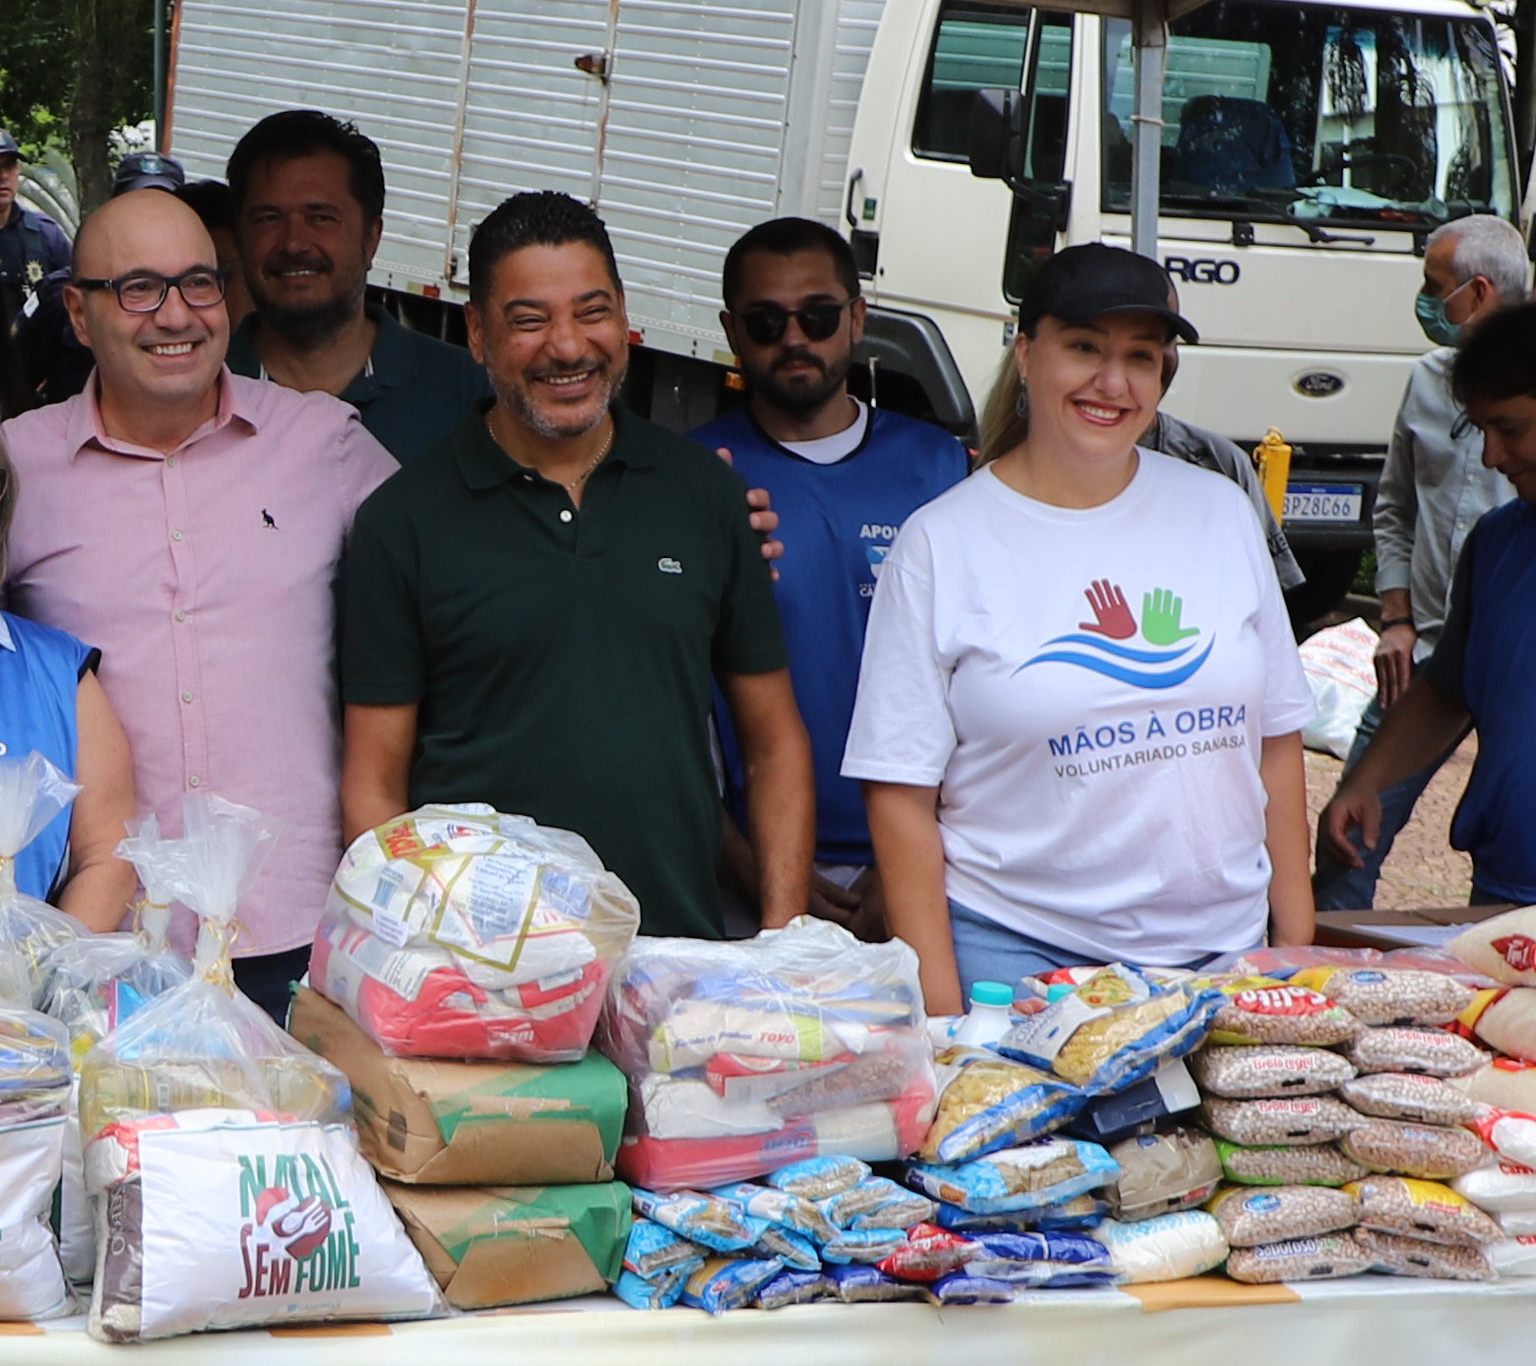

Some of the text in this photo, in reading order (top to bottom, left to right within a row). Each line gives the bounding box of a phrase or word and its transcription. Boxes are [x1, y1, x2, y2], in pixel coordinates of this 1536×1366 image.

[1164, 256, 1240, 285] RGO
[860, 524, 899, 540] APOI
[1048, 704, 1246, 757] MÃOS À OBRA
[1055, 734, 1246, 778] VOLUNTARIADO SANASA
[238, 1211, 362, 1299] SEM FOME
